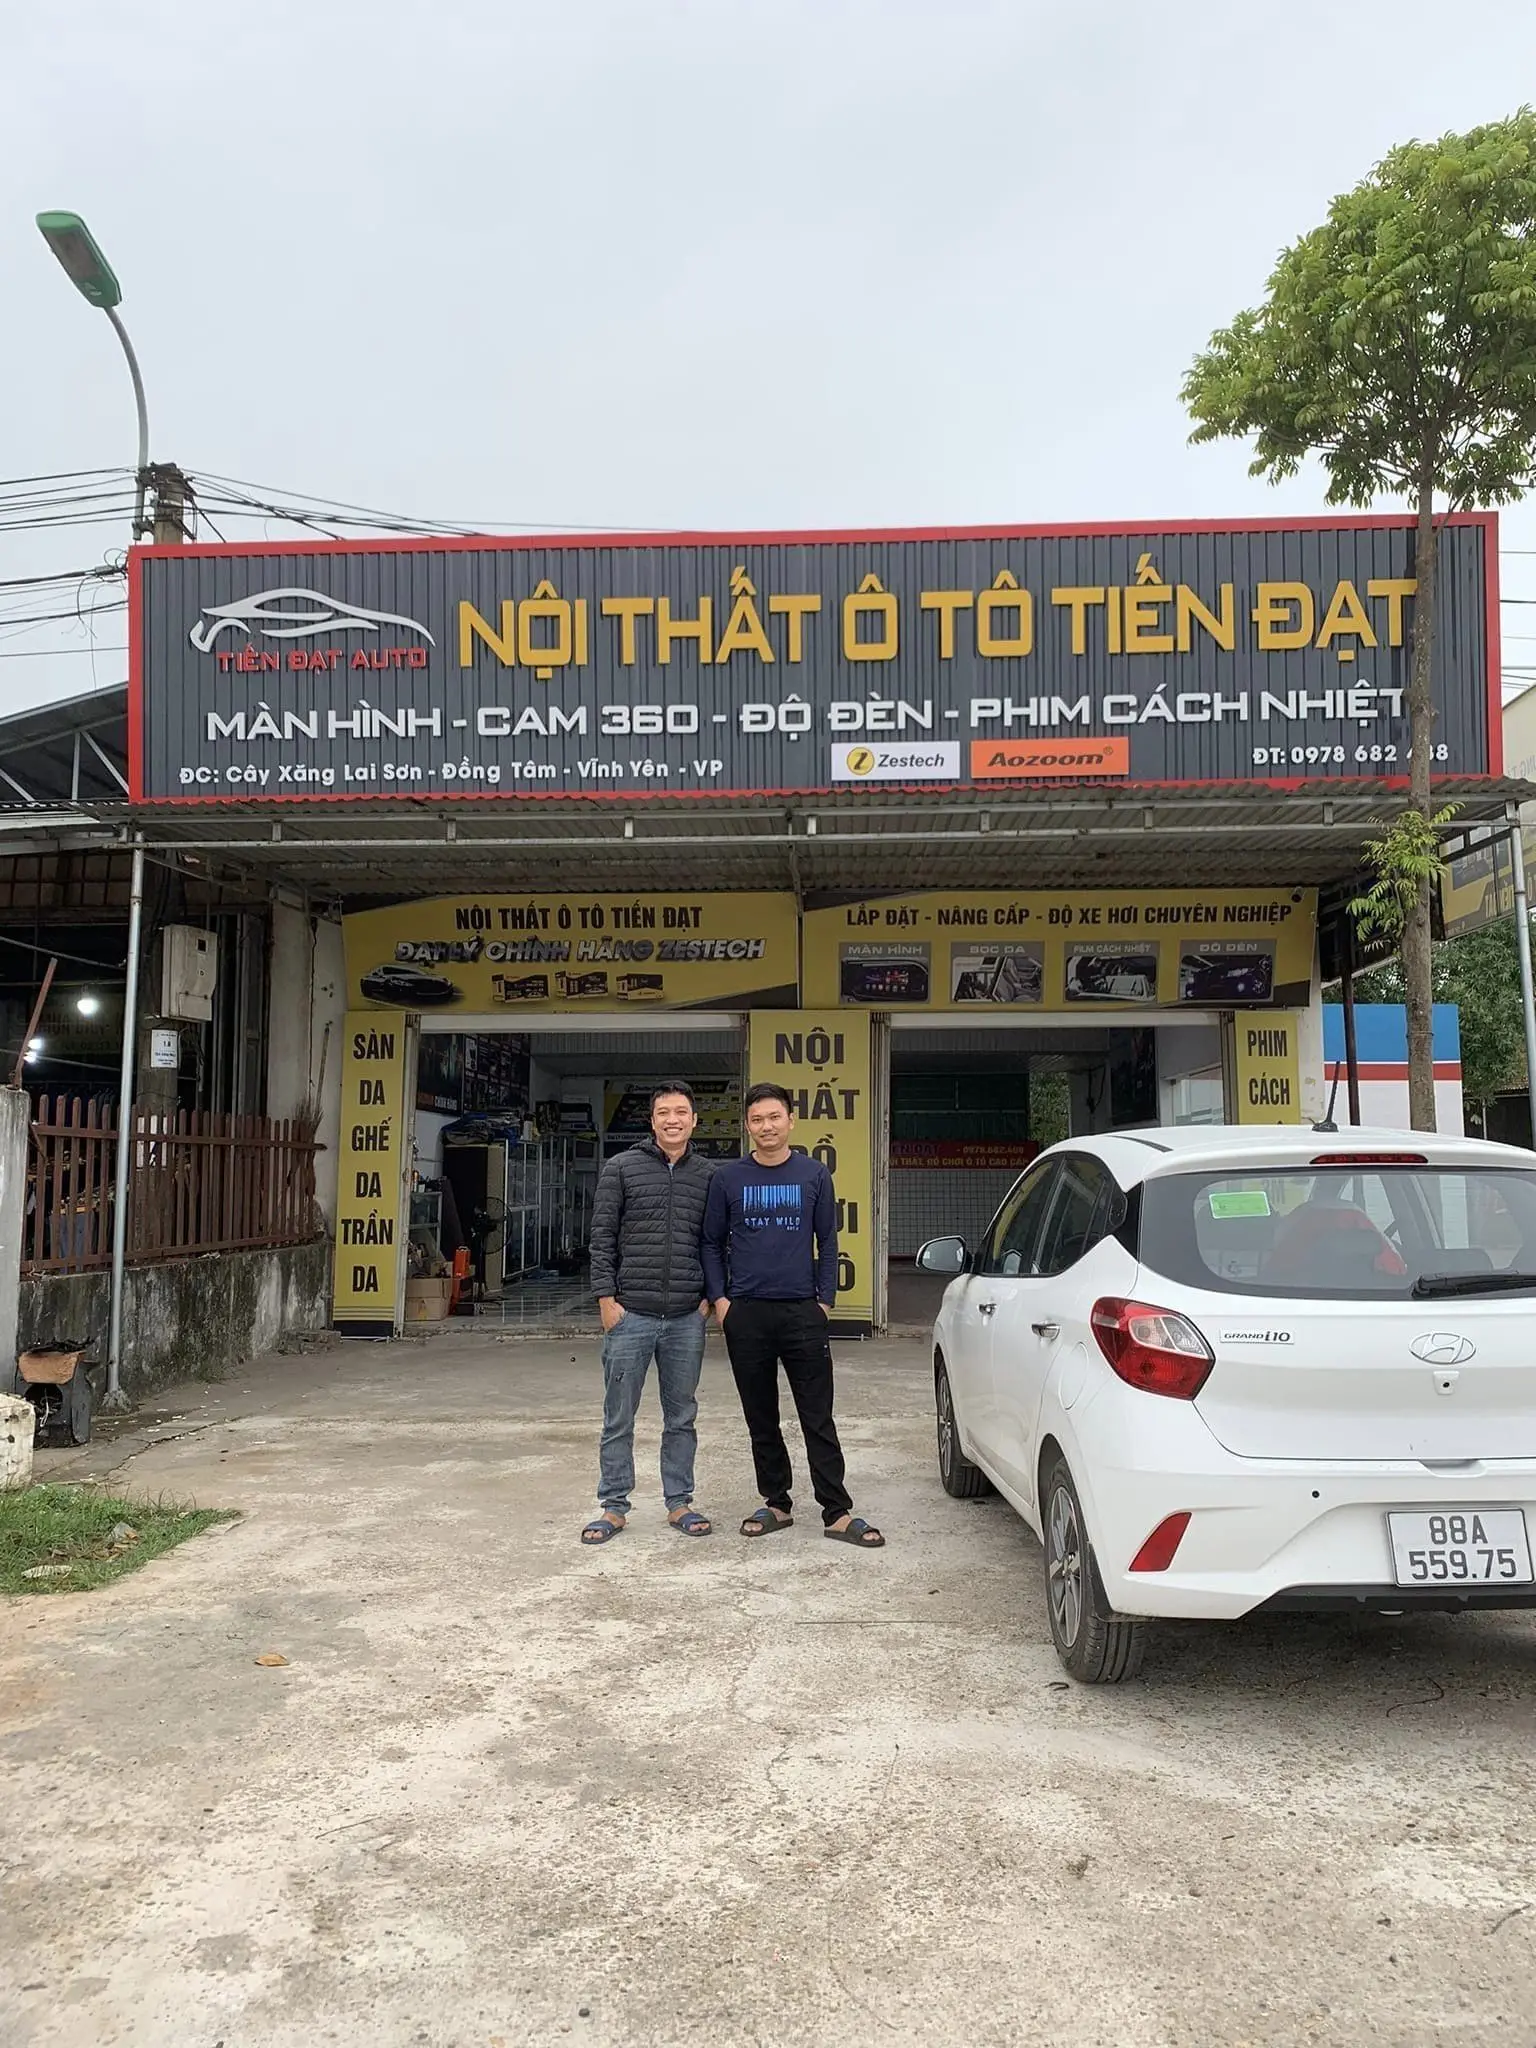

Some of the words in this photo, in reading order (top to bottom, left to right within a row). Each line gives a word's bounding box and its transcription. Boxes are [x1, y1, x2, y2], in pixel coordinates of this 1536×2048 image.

[460, 579, 588, 679] NỘI
[602, 565, 822, 664] THẤT
[843, 573, 898, 661] Ô
[920, 570, 1033, 659] TÔ
[1052, 554, 1235, 655] TIẾN
[1252, 578, 1418, 662] ĐẠT
[288, 649, 343, 675] ĐẠT
[351, 648, 427, 669] AUTO
[207, 701, 318, 741] MÀN
[328, 699, 441, 739] HÌNH
[478, 705, 587, 736] CAM
[602, 704, 699, 735] 360
[740, 694, 812, 741] ĐỘ
[828, 691, 932, 731] ĐÈN
[971, 695, 1090, 728] PHIM
[1103, 683, 1248, 724] CÁCH
[1261, 678, 1404, 727] NHIỆT
[878, 754, 944, 768] Zestech
[1253, 747, 1286, 765] ĐT:
[1291, 745, 1346, 764] 0978
[1355, 744, 1397, 762] 682
[179, 766, 220, 784] ĐC:
[226, 763, 270, 786] Cây
[279, 763, 335, 786] Xăng
[344, 762, 377, 781] Lai
[383, 762, 422, 780] Sơn
[441, 755, 501, 784] Đồng
[511, 759, 557, 779] Tâm
[577, 757, 624, 778] Vĩnh
[629, 758, 669, 778] Yên
[693, 759, 723, 777] VP
[455, 904, 492, 934] NỘI
[498, 900, 550, 930] THẤT
[557, 903, 571, 929] Ô
[578, 902, 604, 929] TÔ
[611, 899, 656, 928] TIẾN
[663, 906, 703, 933] ĐẠT
[937, 904, 988, 926] NÂNG
[993, 902, 1030, 925] CẤP
[1048, 904, 1073, 928] ĐỘ
[1078, 907, 1101, 924] XE
[1108, 905, 1138, 924] HƠI
[1144, 902, 1218, 924] CHUYÊN
[1223, 901, 1292, 926] NGHIỆP
[656, 937, 768, 962] ZESTECH
[353, 1028, 394, 1060] SÀN
[775, 1026, 844, 1071] NỘI
[1247, 1030, 1287, 1057] PHIM
[359, 1080, 385, 1106] DA
[784, 1077, 860, 1120] HẤT
[1249, 1072, 1290, 1106] CÁCH
[351, 1117, 393, 1152] GHẾ
[356, 1172, 382, 1198] DA
[341, 1209, 394, 1245] TRẦN
[744, 1217, 770, 1226] STAY
[776, 1216, 801, 1226] WILD
[352, 1266, 379, 1293] DA
[1428, 1515, 1488, 1545] 88A
[1409, 1549, 1517, 1580] 559.75
